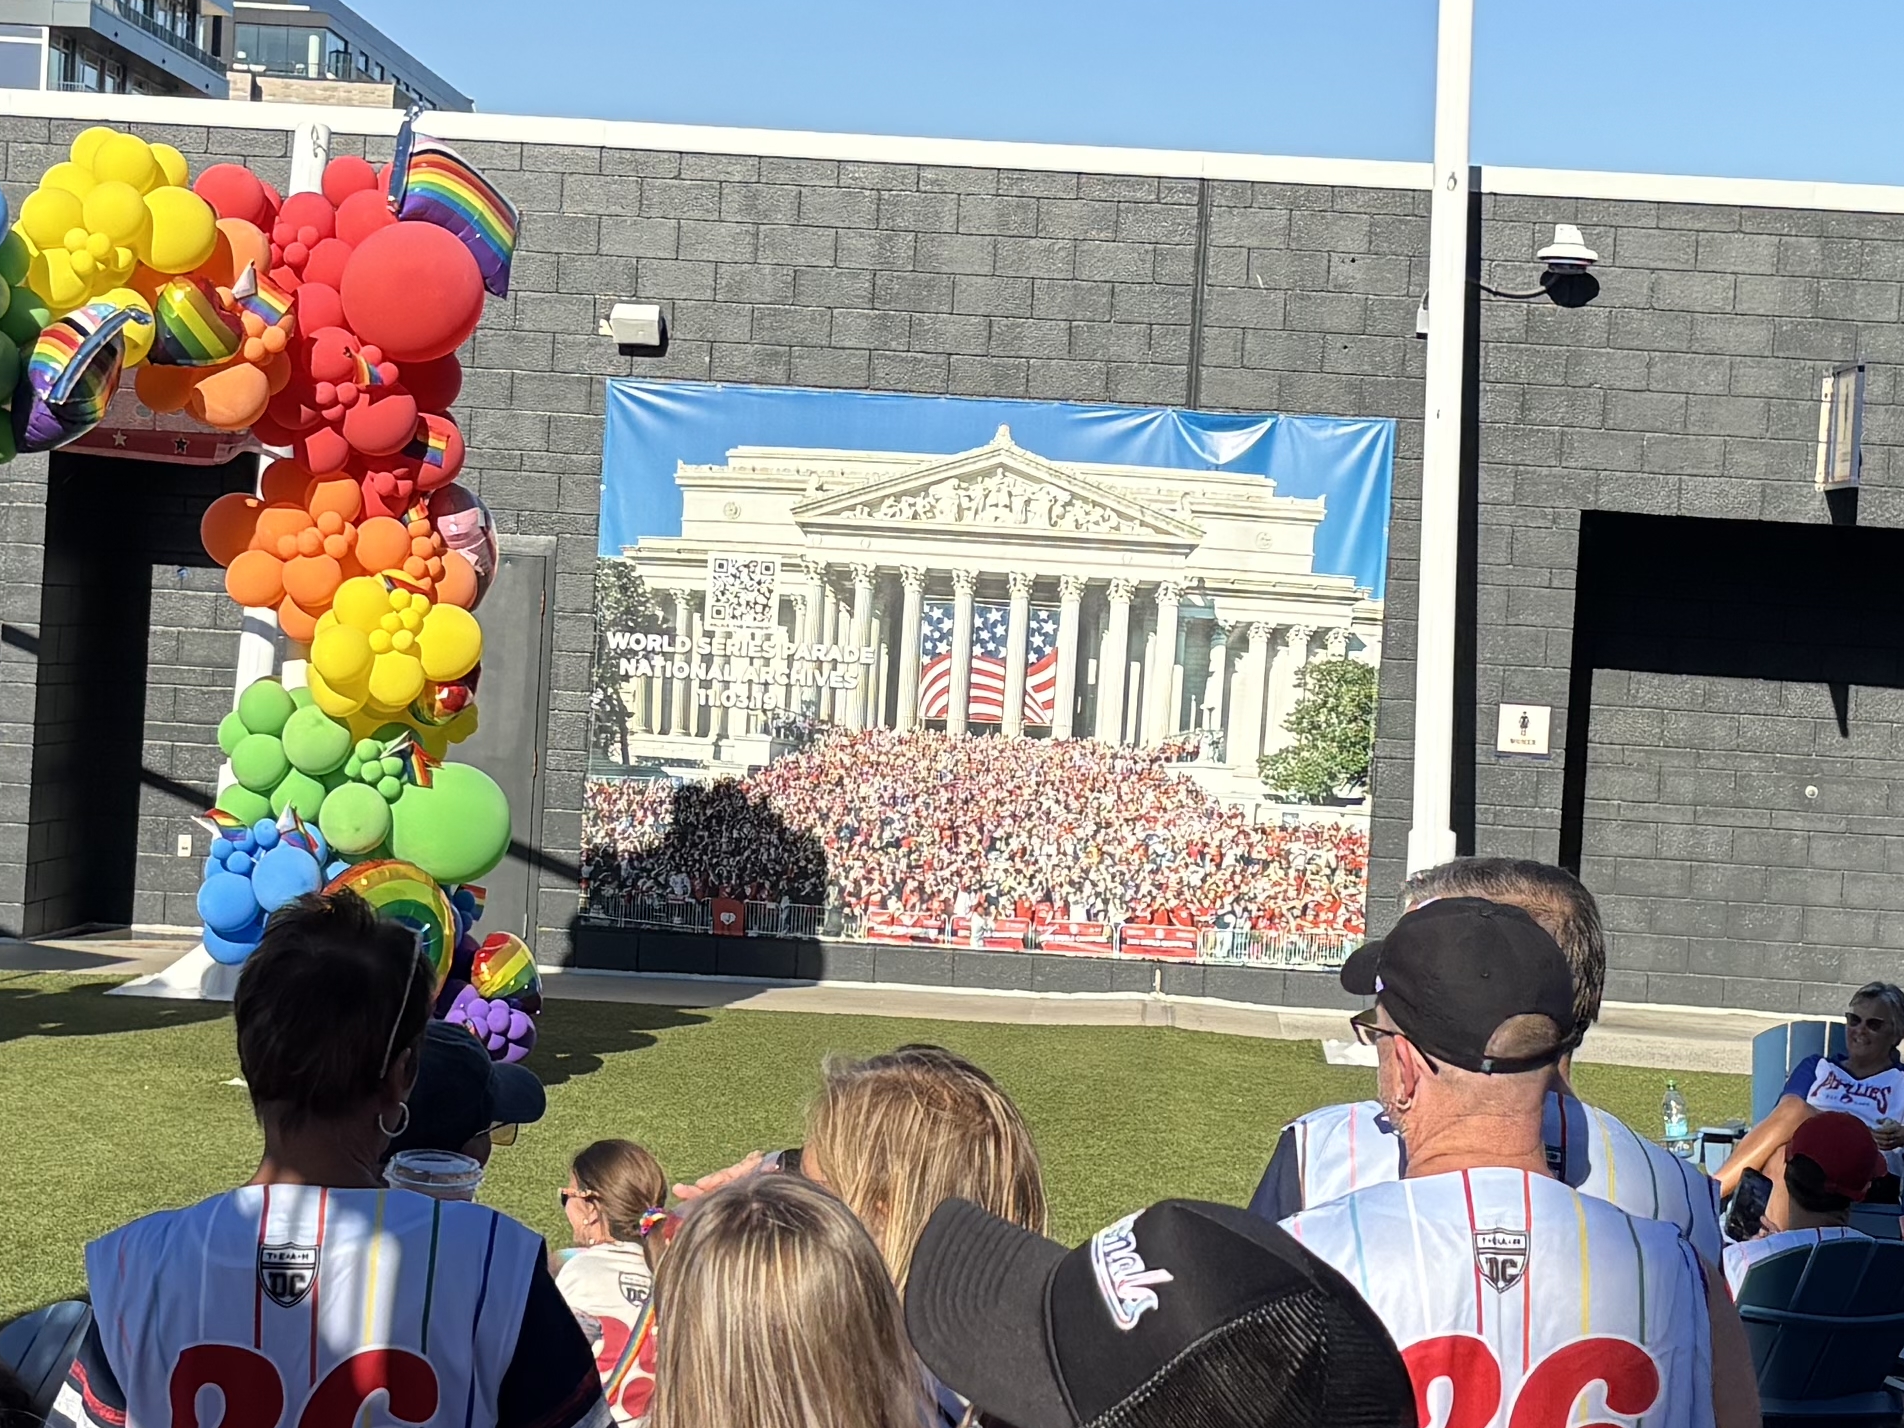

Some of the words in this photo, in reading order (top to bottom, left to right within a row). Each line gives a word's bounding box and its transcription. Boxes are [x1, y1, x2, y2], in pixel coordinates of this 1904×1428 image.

[607, 631, 692, 654] WORLD
[696, 637, 777, 659] SERIES
[781, 643, 876, 665] PARADE
[619, 658, 738, 682] NATIONAL
[739, 665, 859, 690] ARCHIVES
[697, 689, 777, 710] 11.03.19
[268, 1272, 307, 1298] DC
